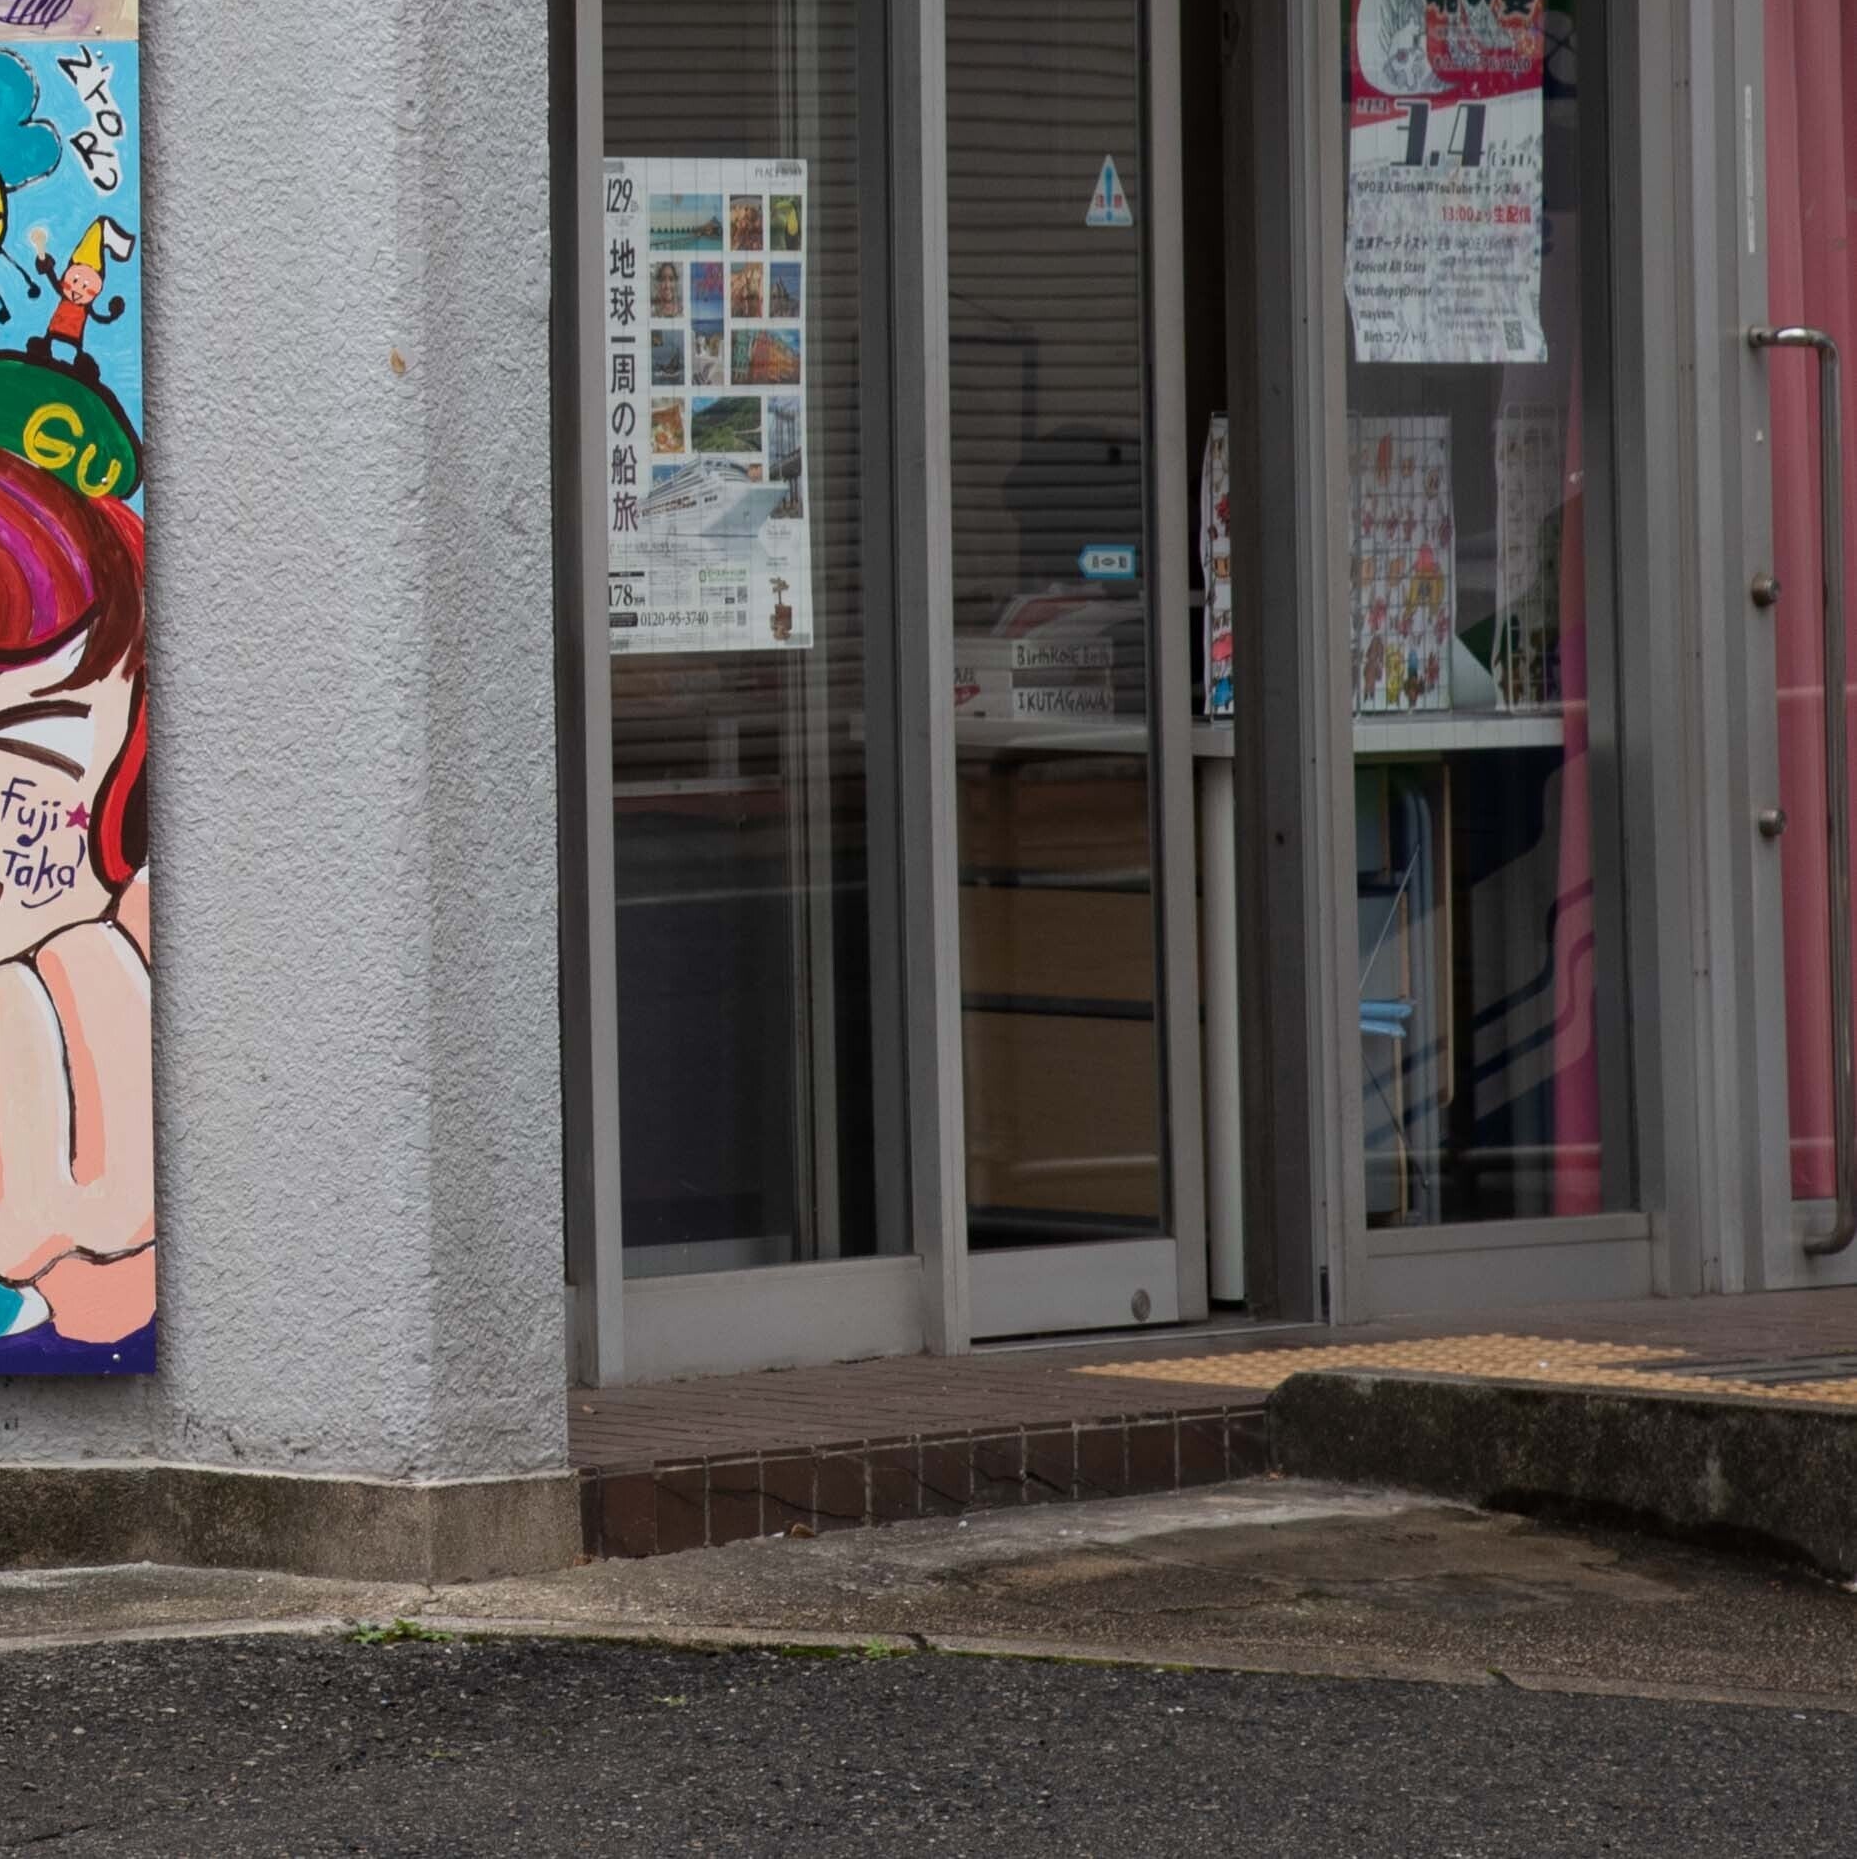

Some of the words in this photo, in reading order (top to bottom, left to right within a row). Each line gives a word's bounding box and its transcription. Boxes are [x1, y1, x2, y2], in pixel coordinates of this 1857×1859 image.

[609, 237, 639, 533] 地球一周の船旅
[0, 777, 62, 848] Fuji
